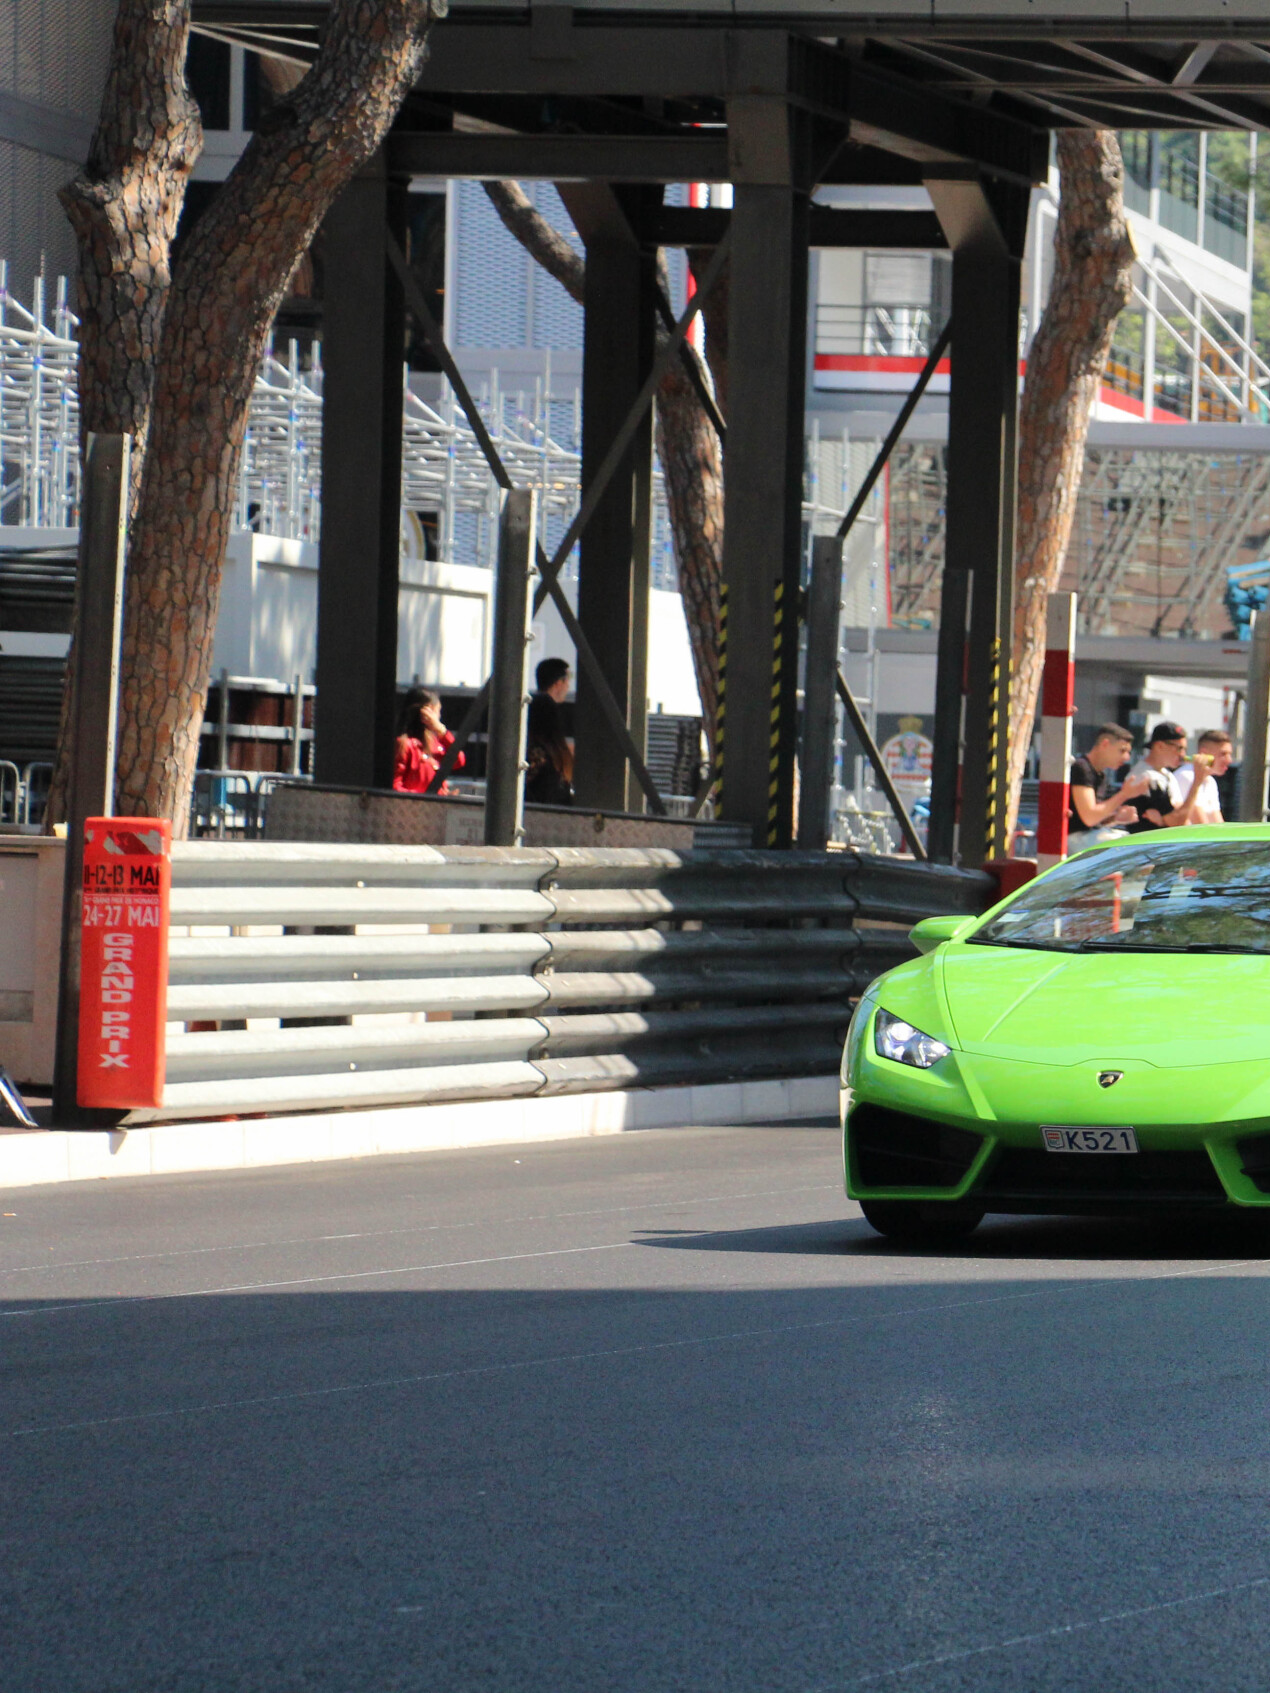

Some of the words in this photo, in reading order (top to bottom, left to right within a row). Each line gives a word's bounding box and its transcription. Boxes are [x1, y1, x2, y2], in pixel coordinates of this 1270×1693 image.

[84, 865, 124, 885] 11-12-13
[131, 865, 160, 886] MAI
[83, 904, 122, 927] 24-27
[128, 905, 160, 927] MAI
[101, 933, 135, 1004] GRAND
[98, 1011, 130, 1068] PRIX
[1065, 1131, 1131, 1151] K521
